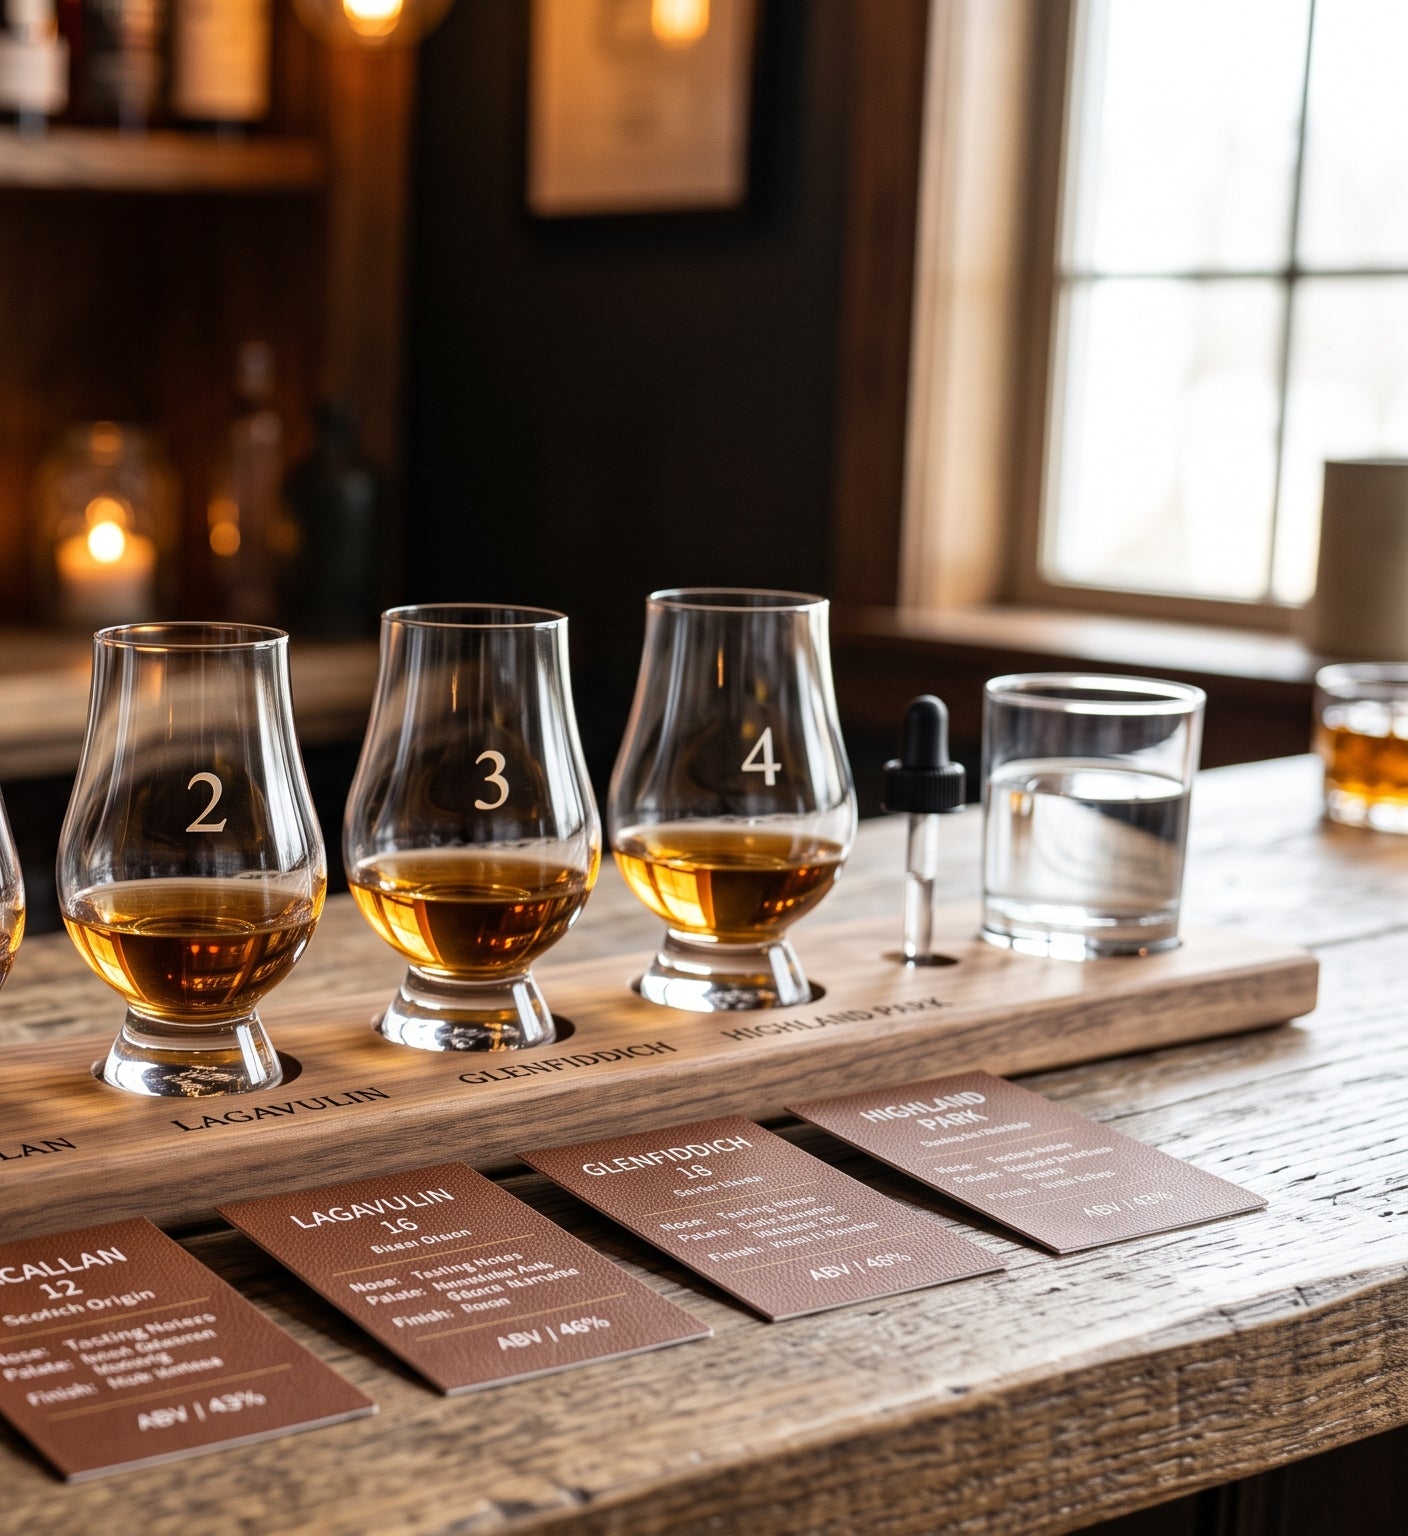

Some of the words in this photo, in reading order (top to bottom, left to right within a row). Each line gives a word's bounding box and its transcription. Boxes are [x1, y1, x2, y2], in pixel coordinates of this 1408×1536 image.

[740, 727, 782, 786] 4
[474, 750, 510, 810] 3
[185, 772, 228, 833] 2
[720, 1005, 879, 1042] HIGHLAND
[874, 997, 954, 1018] PARK
[458, 1040, 678, 1085] GLENFIDDICH
[170, 1087, 391, 1132] LAGAVULIN
[859, 1090, 987, 1124] HIGHLAND
[918, 1109, 989, 1133] PARK
[582, 1135, 754, 1178] GLENFIDDICH
[676, 1165, 713, 1180] 18
[290, 1187, 455, 1230] LAGAVULIN
[381, 1217, 418, 1235] 16
[1083, 1201, 1121, 1218] ABV
[40, 1279, 84, 1300] 12
[809, 1263, 850, 1281] ABV
[86, 1288, 156, 1310] Origin
[497, 1328, 542, 1351] ABV
[560, 1315, 611, 1335] 46%
[137, 1404, 189, 1432] ABV
